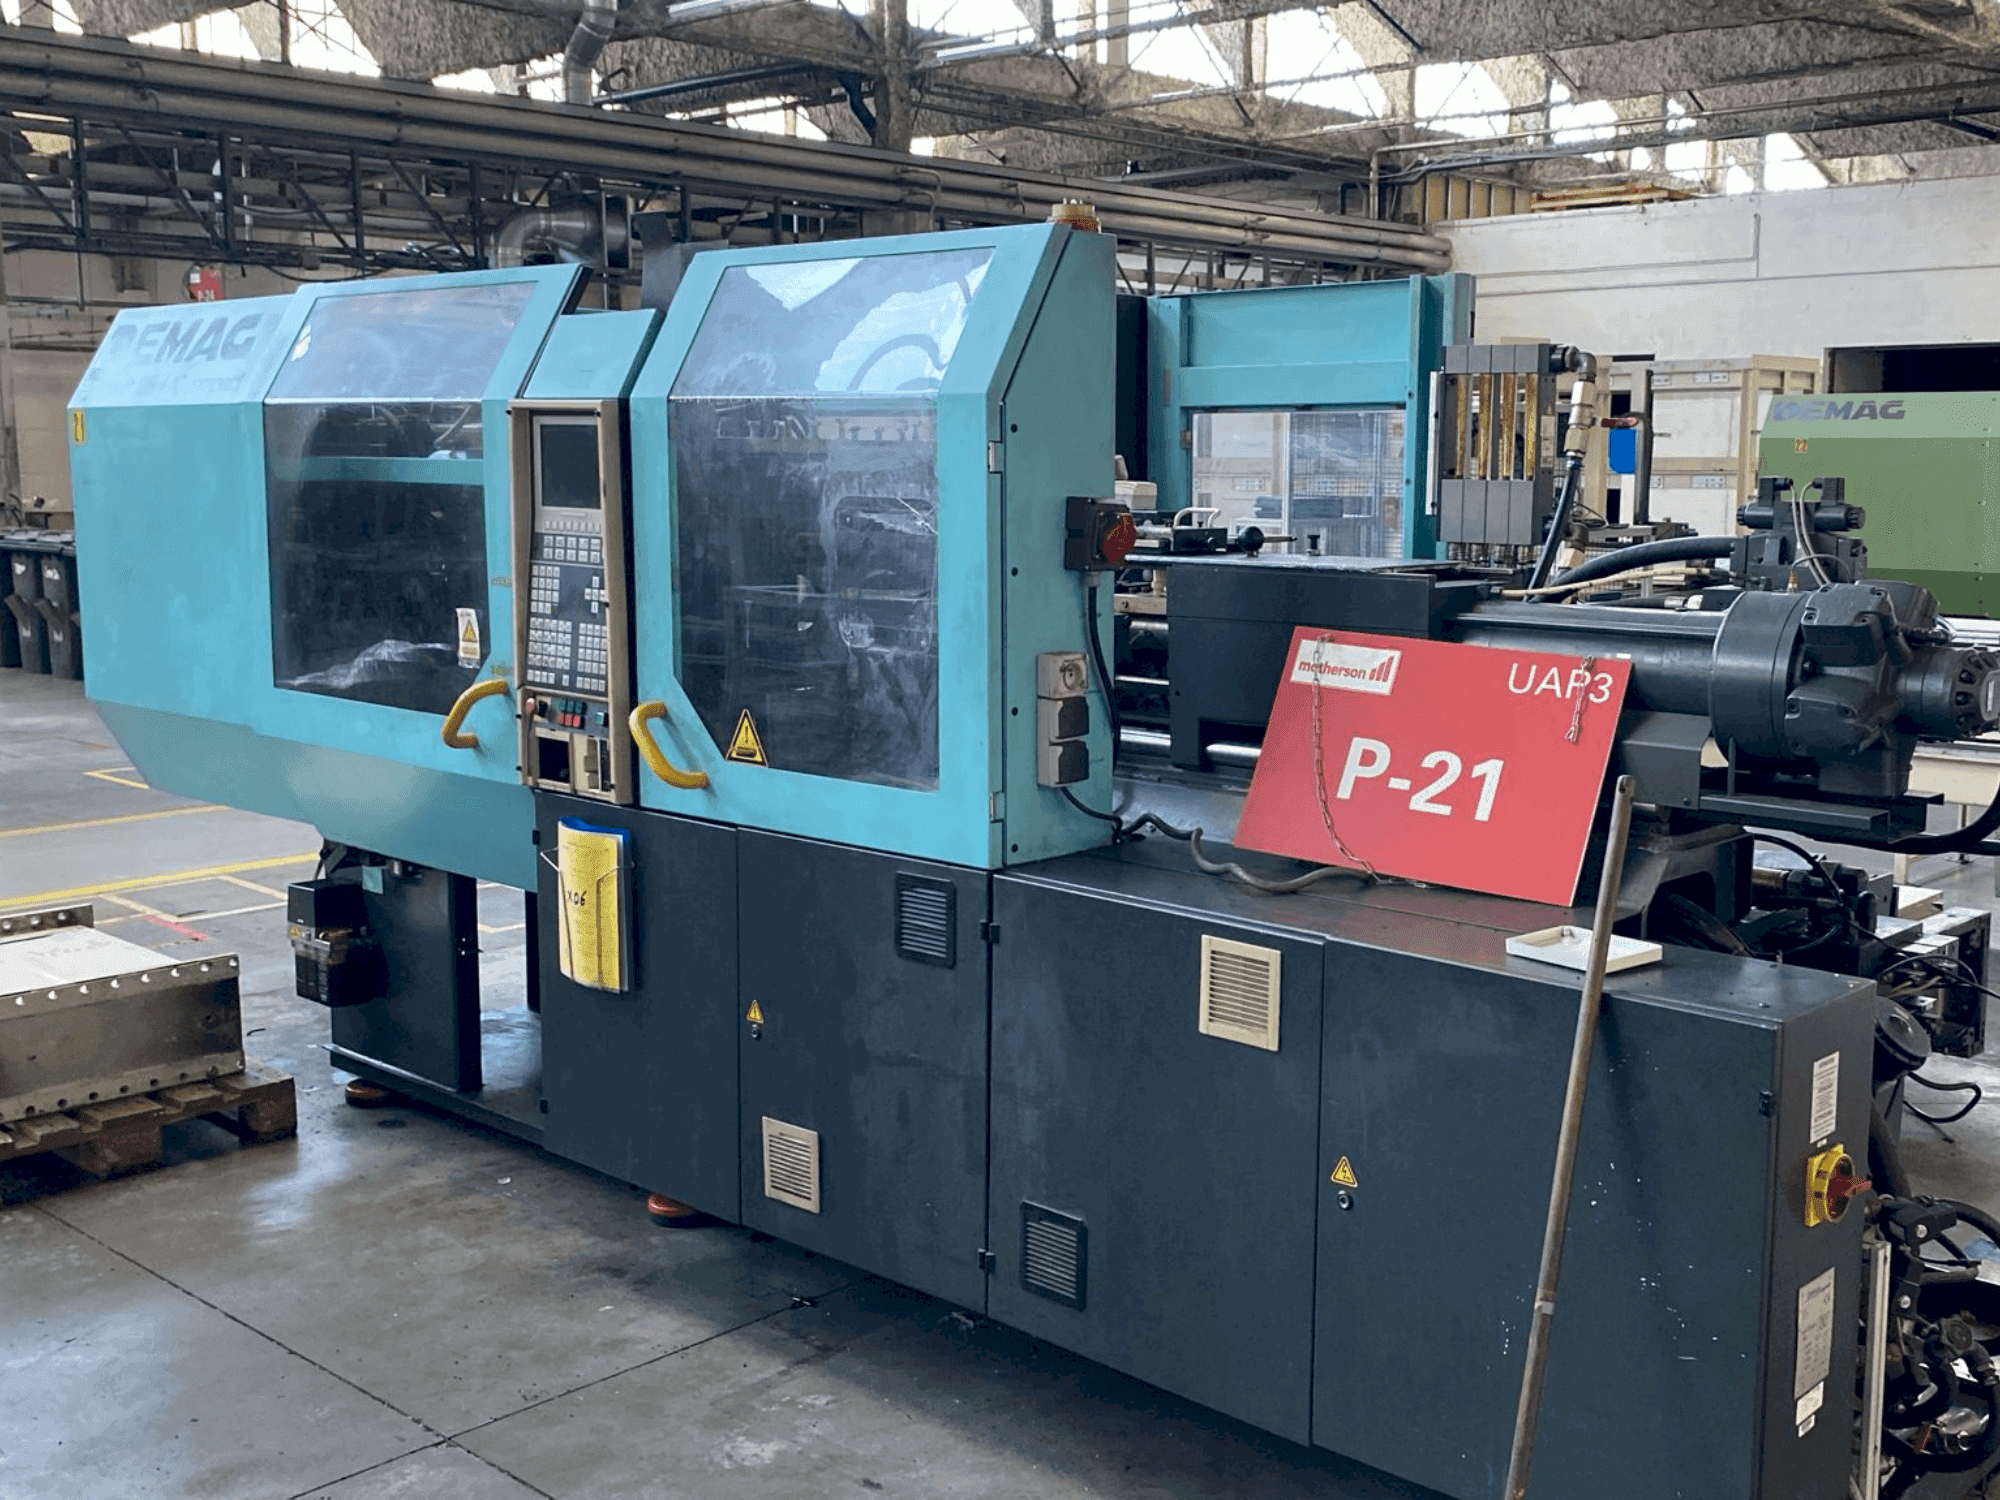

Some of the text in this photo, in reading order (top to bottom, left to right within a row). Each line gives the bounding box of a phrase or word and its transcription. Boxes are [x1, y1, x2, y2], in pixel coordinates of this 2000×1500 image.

[1773, 399, 1907, 421] DEMAG
[1298, 660, 1367, 680] motherson
[1508, 662, 1613, 704] UAP3
[1336, 736, 1505, 822] P-21
